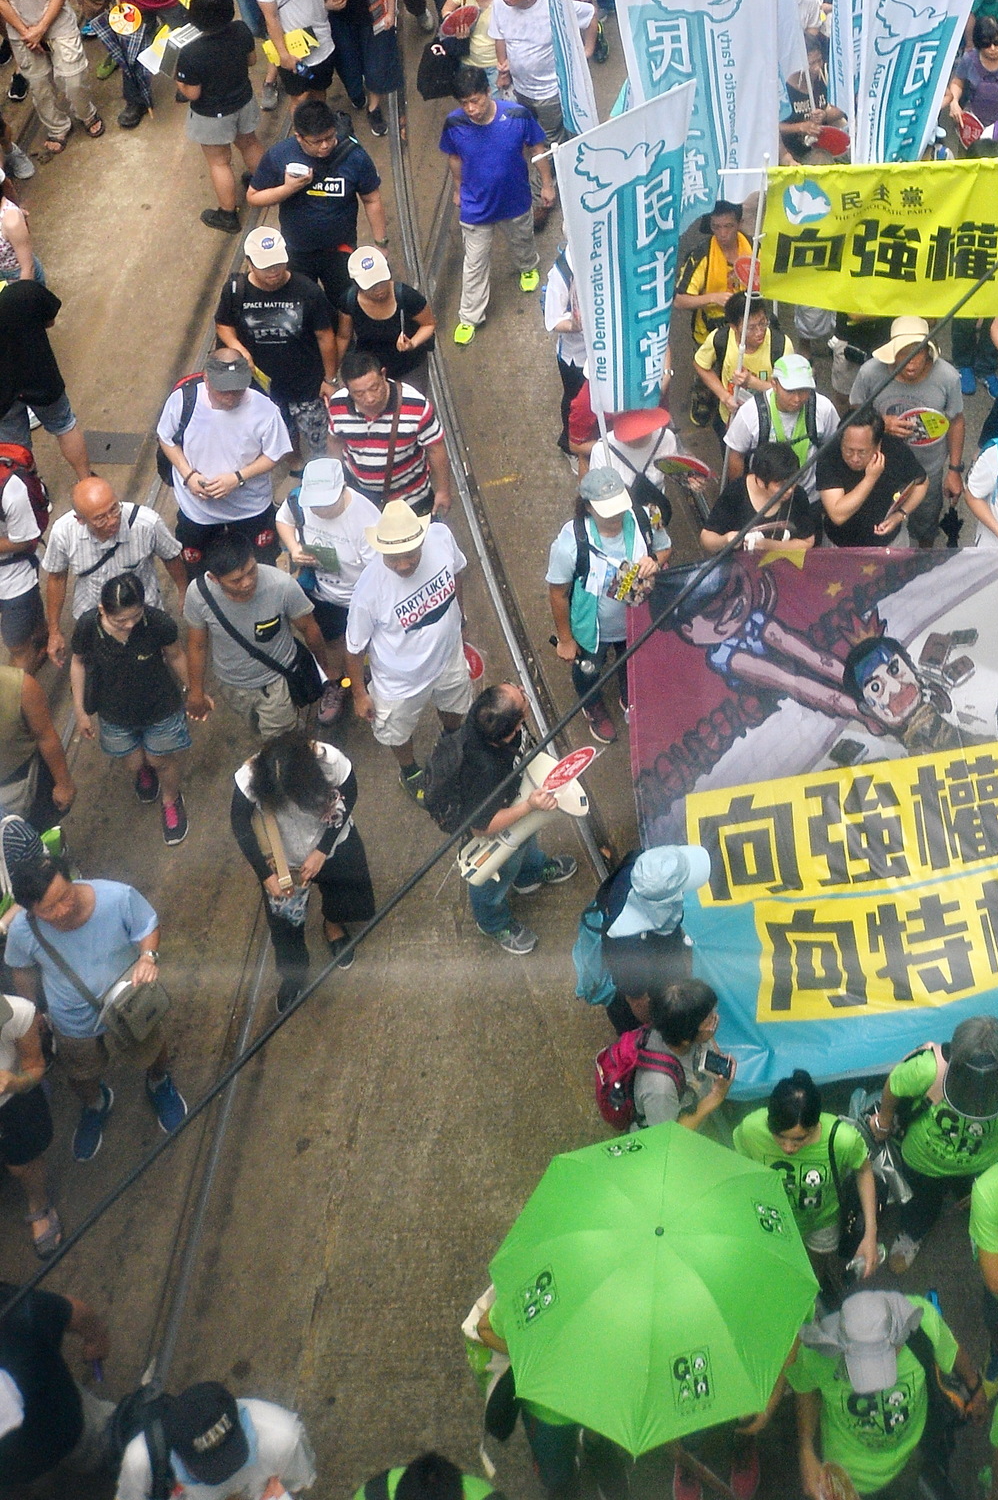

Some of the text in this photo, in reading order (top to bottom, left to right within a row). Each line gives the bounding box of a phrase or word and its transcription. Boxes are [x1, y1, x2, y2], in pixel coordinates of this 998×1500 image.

[324, 182, 340, 192] 689
[840, 184, 925, 211] 民主黨
[243, 301, 295, 311] SPACE MATTERS
[595, 219, 608, 382] The Democratic Party
[634, 174, 676, 398] 民主黨
[394, 593, 426, 619] PARTY
[422, 578, 447, 602] LIKE
[400, 581, 457, 629] ROCKSTAR
